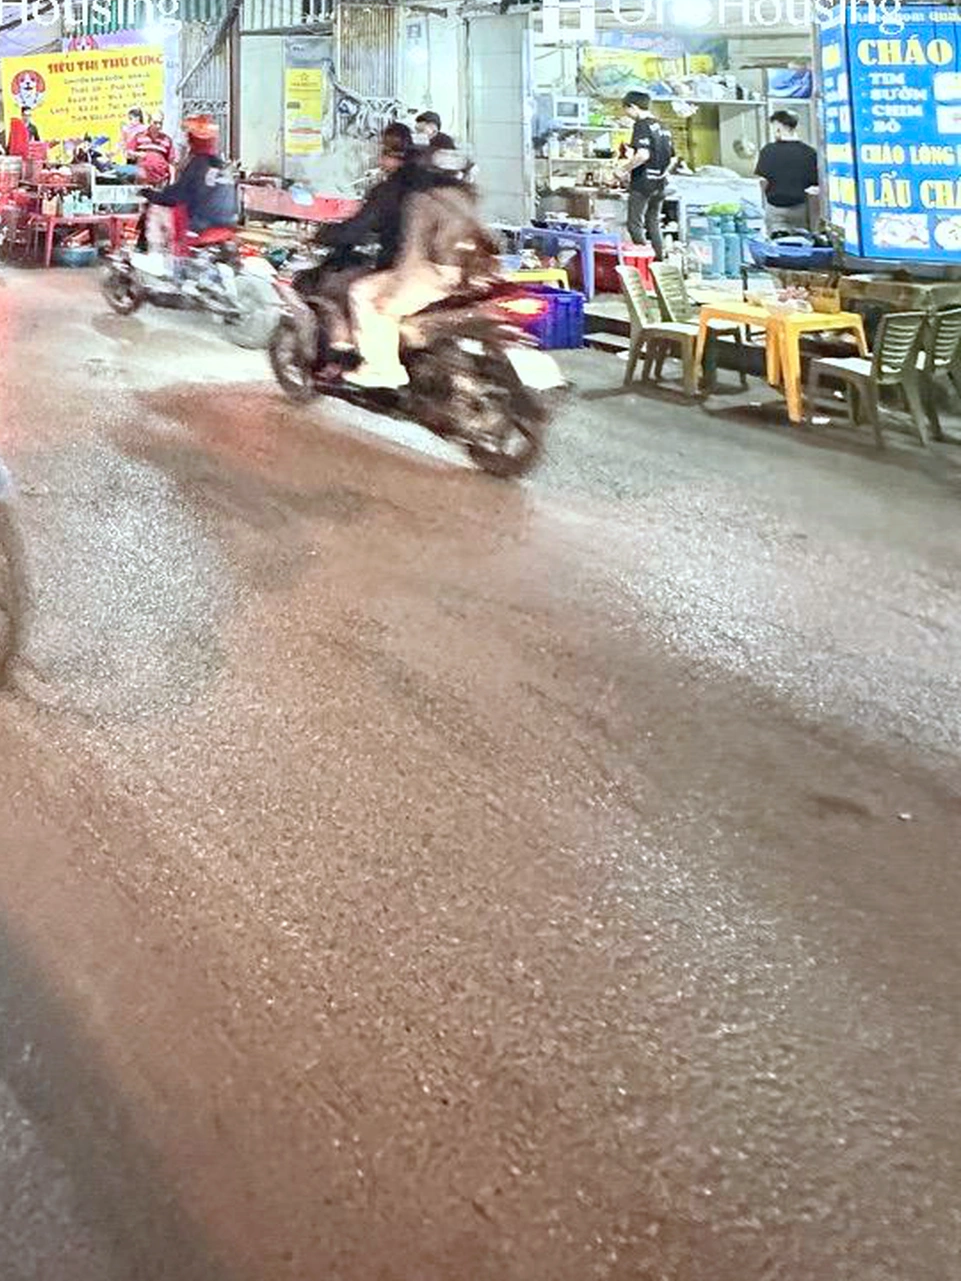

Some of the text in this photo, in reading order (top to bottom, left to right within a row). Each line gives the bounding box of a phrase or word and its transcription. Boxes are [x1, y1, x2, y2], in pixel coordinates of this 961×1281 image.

[857, 34, 953, 66] CHÁO
[868, 73, 905, 85] TIM
[871, 104, 923, 117] CHIM
[861, 142, 905, 165] CHÁO
[908, 142, 956, 166] LÒNG
